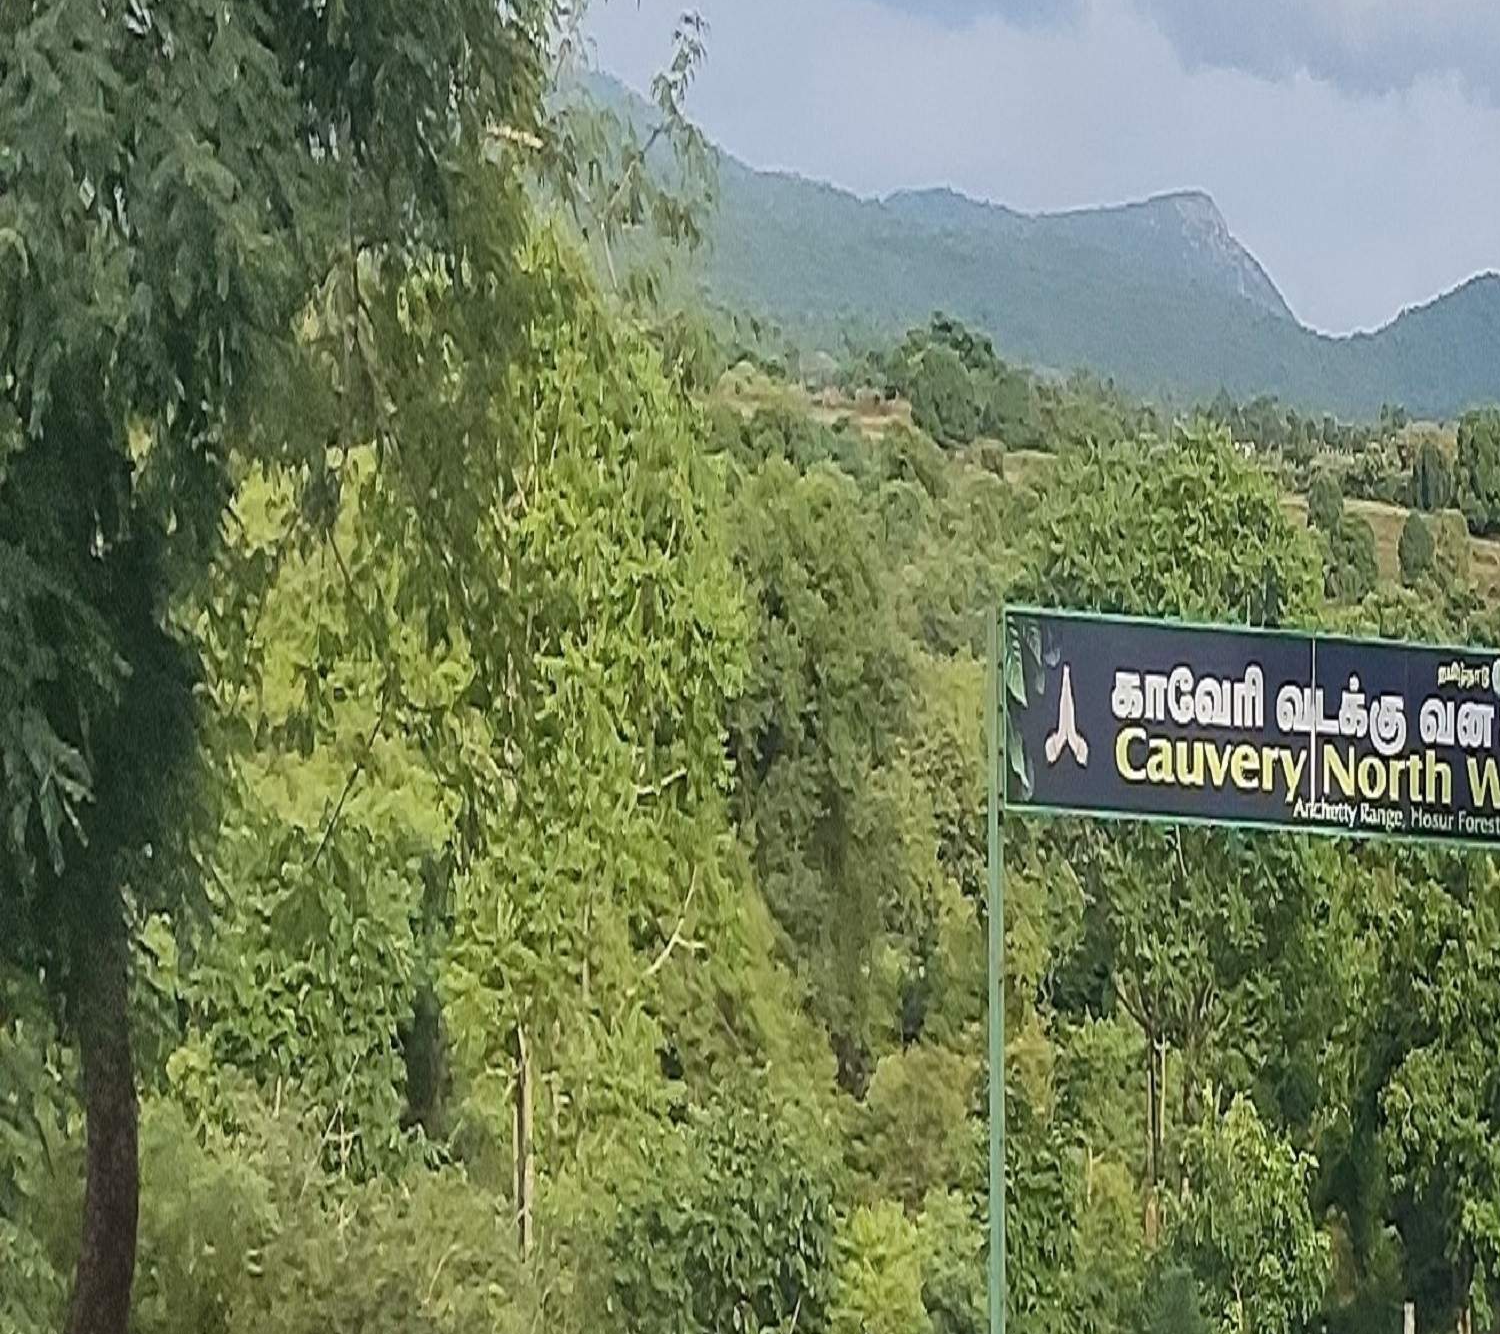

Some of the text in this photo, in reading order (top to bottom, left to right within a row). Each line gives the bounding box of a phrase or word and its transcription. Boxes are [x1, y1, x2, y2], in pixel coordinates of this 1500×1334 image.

[1111, 666, 1264, 729] காவேரி
[1276, 675, 1407, 755] வடக்கு
[1115, 727, 1307, 804] Cauvery
[1322, 743, 1451, 804] North
[1410, 806, 1454, 831] Hosur
[1458, 810, 1500, 835] Forest
